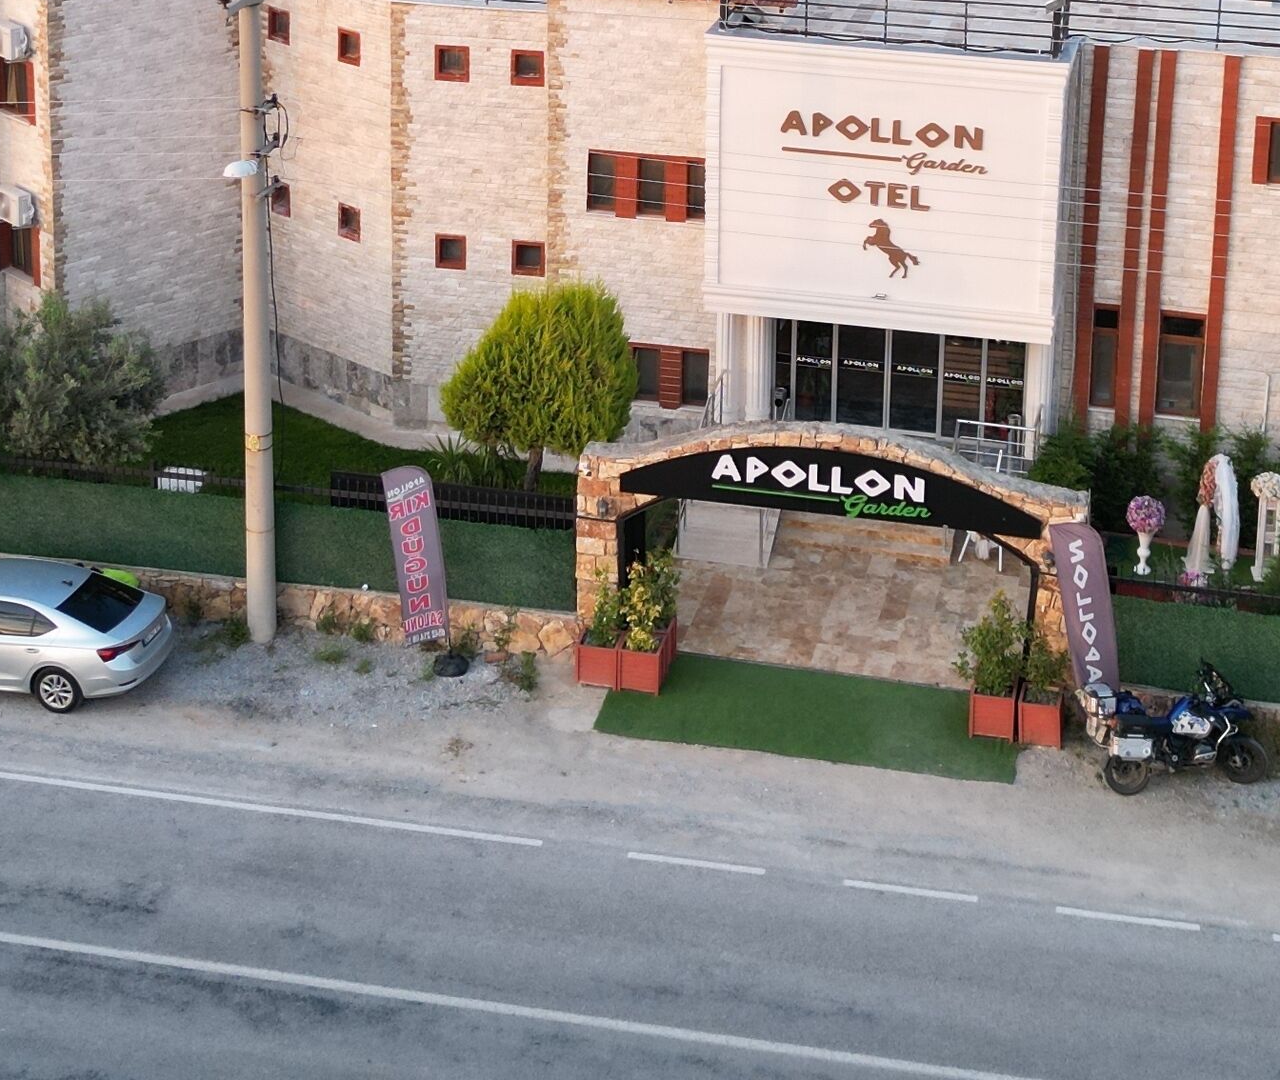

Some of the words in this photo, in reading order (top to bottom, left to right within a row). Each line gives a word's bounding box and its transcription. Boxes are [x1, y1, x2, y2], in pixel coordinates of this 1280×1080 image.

[780, 110, 984, 151] APOLLON
[901, 152, 988, 176] Garden
[827, 178, 931, 212] OTEL
[711, 454, 926, 503] APOLLON
[840, 494, 932, 519] Garden
